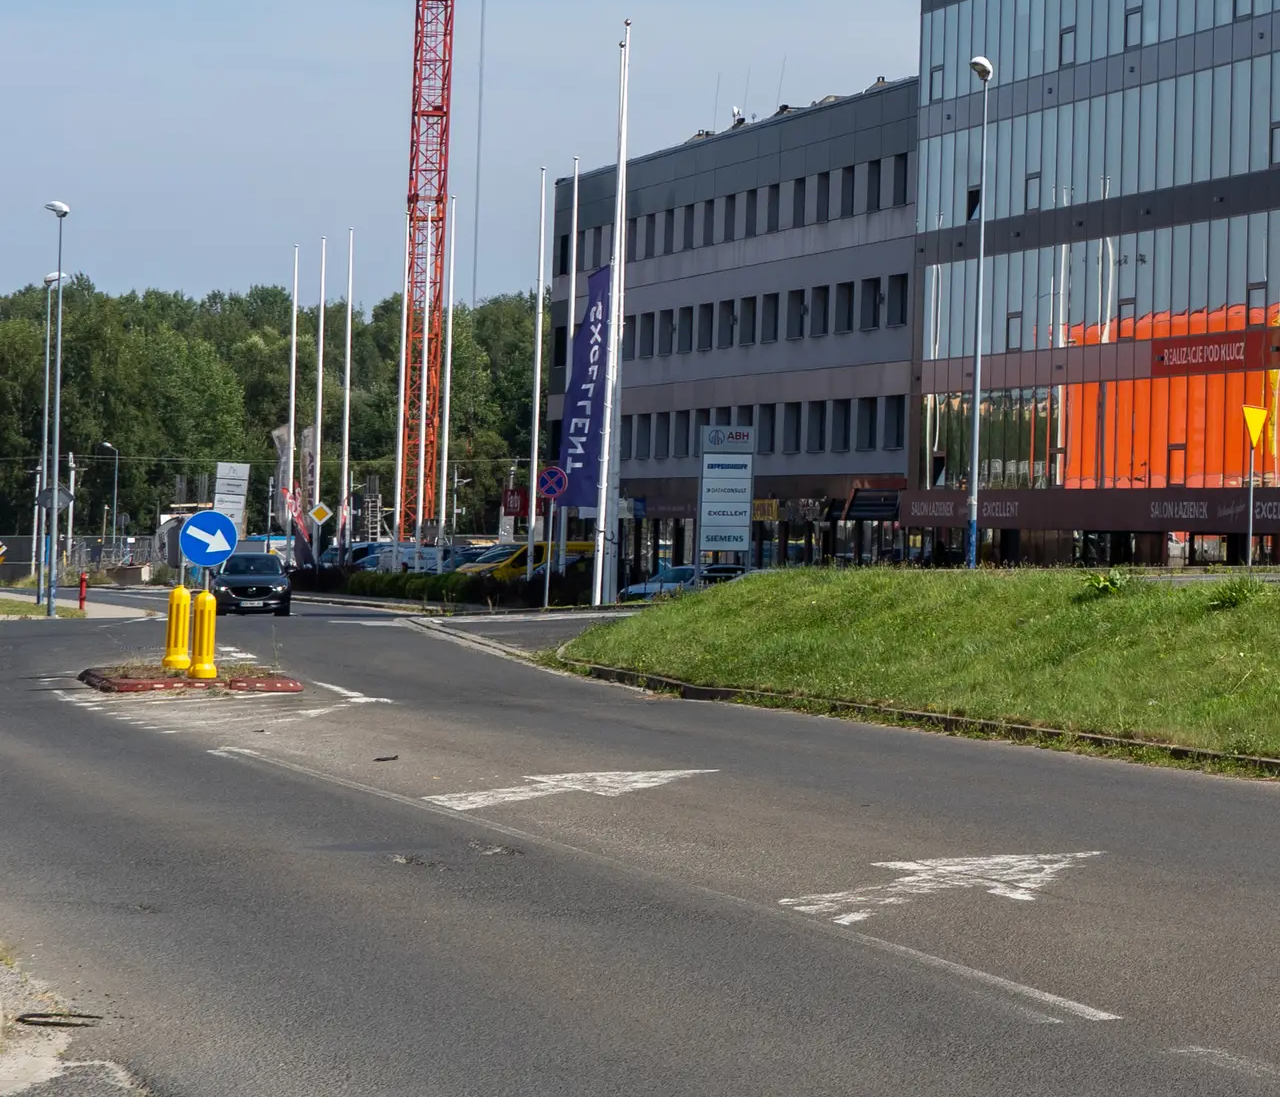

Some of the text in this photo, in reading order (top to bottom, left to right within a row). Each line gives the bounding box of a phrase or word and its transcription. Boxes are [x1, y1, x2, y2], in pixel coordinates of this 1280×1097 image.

[1164, 342, 1245, 366] REALIZACJE POD KLUCZ
[727, 431, 749, 441] ABH
[981, 501, 1020, 517] EXCELLENT
[1150, 501, 1174, 519] SALON
[705, 534, 744, 542] SIEMENS
